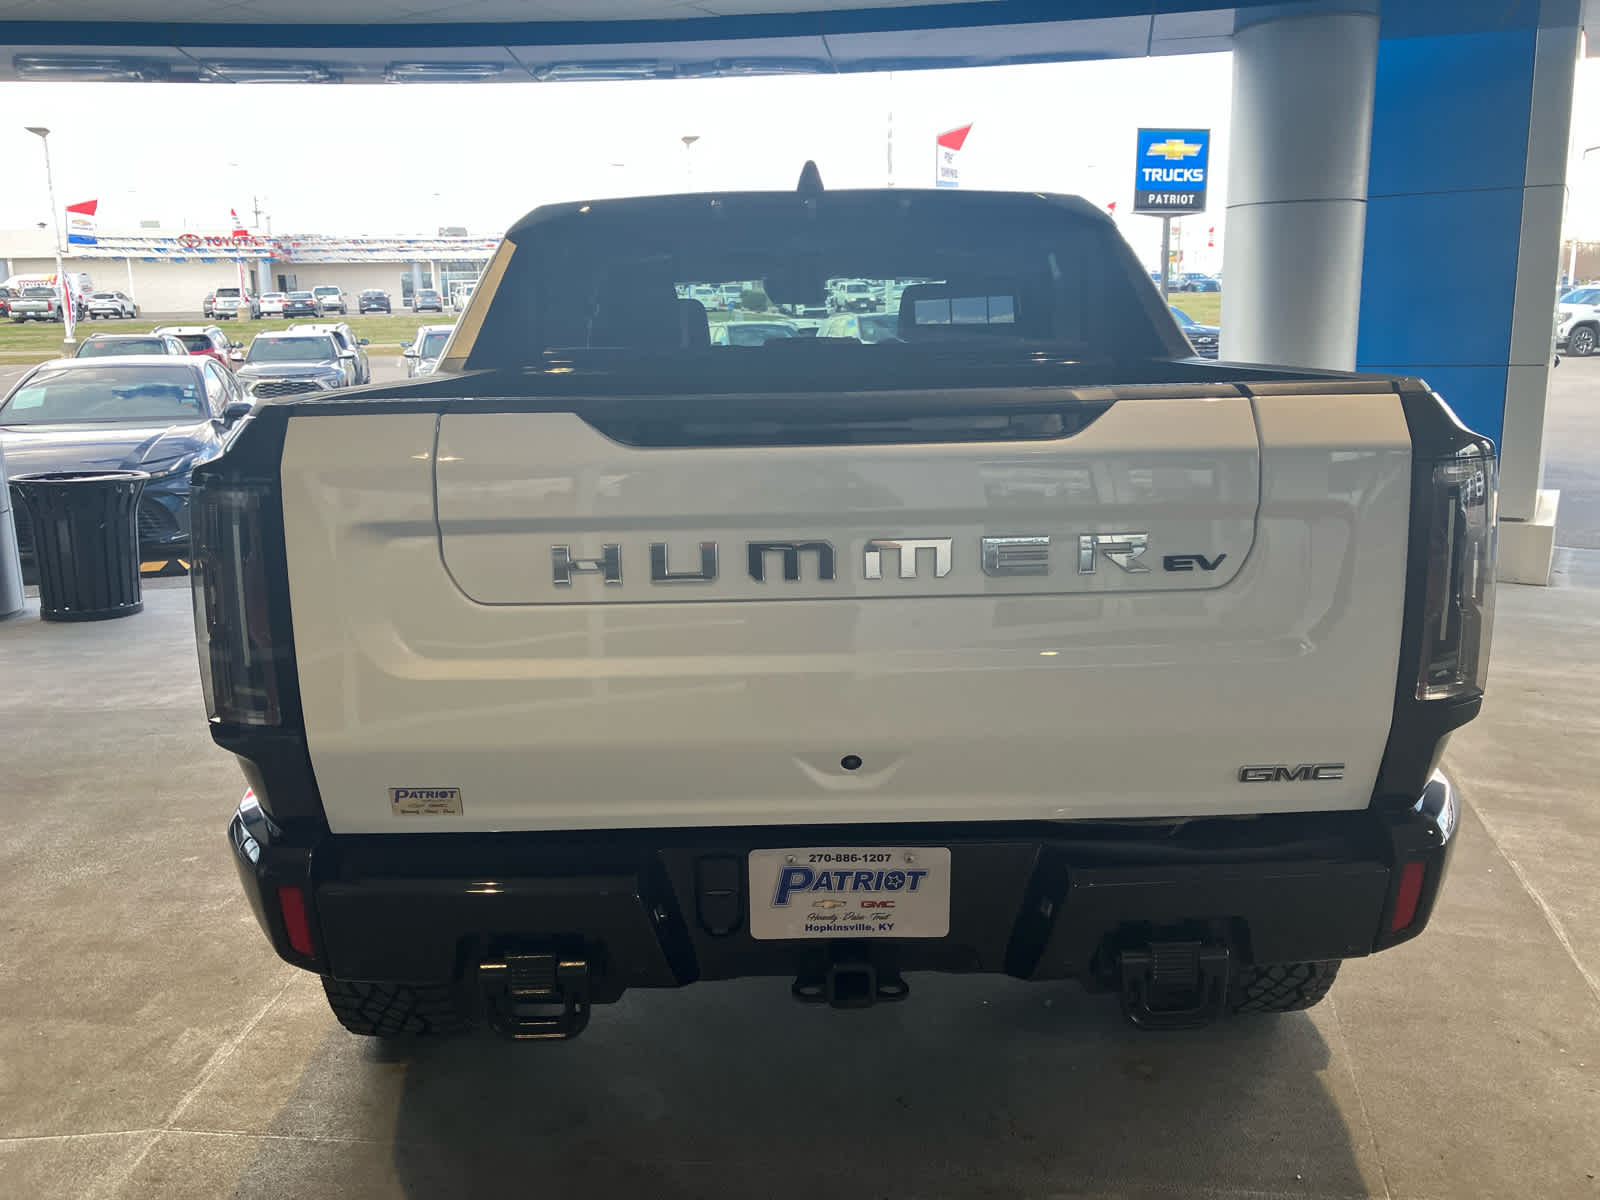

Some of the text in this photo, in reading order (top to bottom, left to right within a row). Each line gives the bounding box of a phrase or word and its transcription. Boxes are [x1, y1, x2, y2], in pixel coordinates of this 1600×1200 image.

[1142, 168, 1204, 182] TRUCKS
[1148, 193, 1195, 204] PATRIOT
[551, 532, 1227, 586] HUMMER EV
[1239, 763, 1345, 782] GMC
[394, 789, 458, 803] PATRIOT
[808, 854, 892, 863] 270-886-1207
[773, 866, 929, 907] PATRIOT
[861, 900, 896, 909] GMC
[805, 922, 895, 933] Hopkinsville, KY
